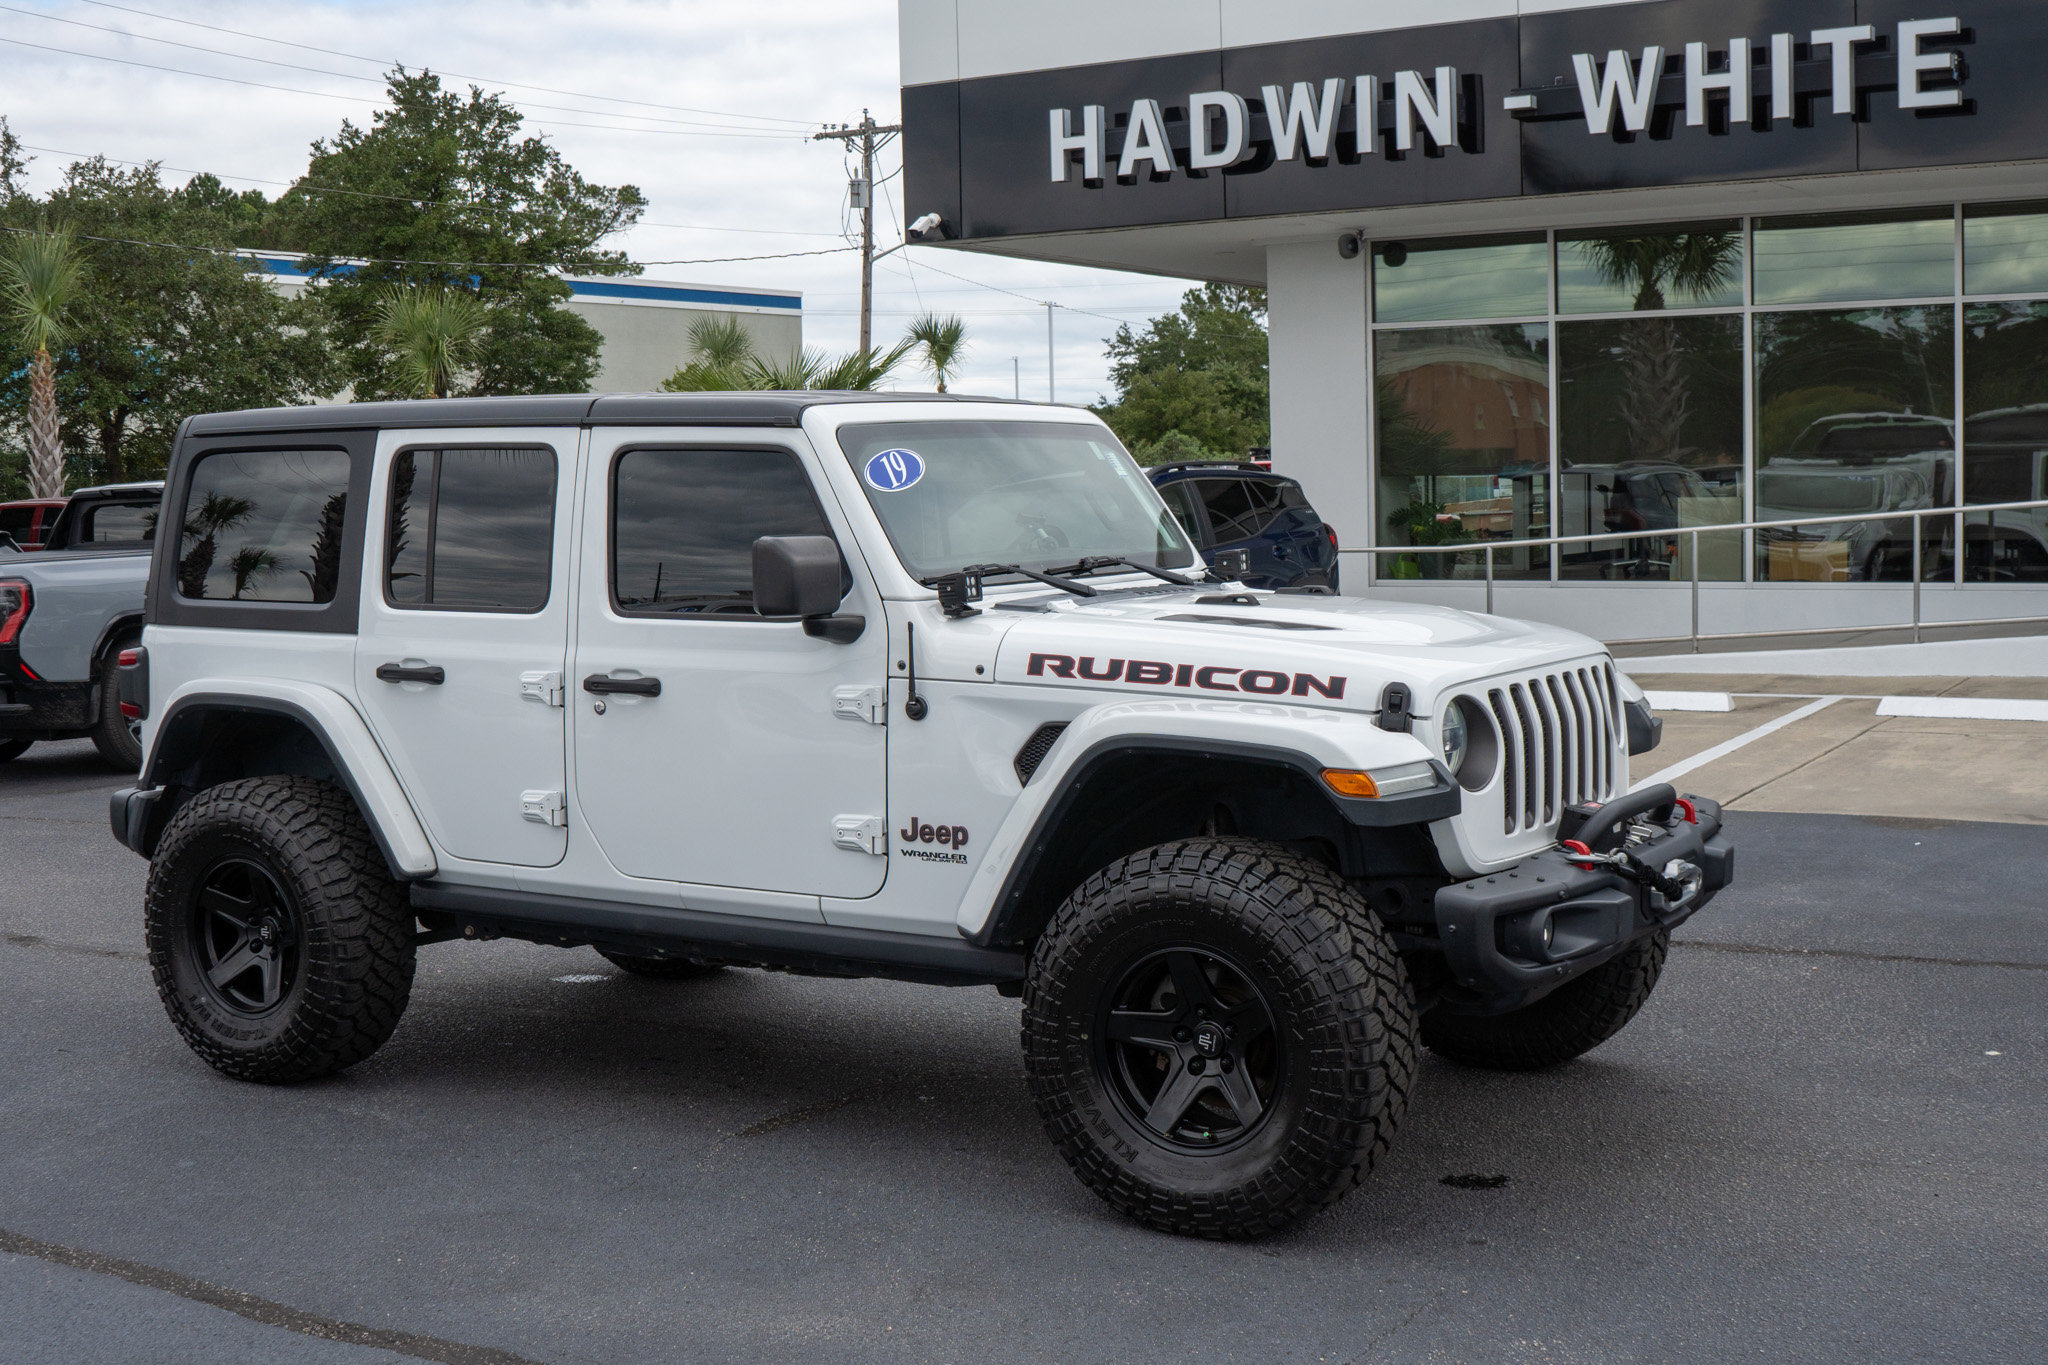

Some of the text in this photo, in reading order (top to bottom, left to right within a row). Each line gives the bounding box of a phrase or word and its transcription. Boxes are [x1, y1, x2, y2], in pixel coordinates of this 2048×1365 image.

[1049, 65, 1458, 183] HADWIN
[1572, 16, 1963, 135] WHITE
[880, 451, 907, 489] 19
[1027, 653, 1347, 699] RUBICON
[901, 816, 969, 850] Jeep
[901, 848, 967, 861] WRANGLER
[921, 856, 968, 865] UNLIMITED
